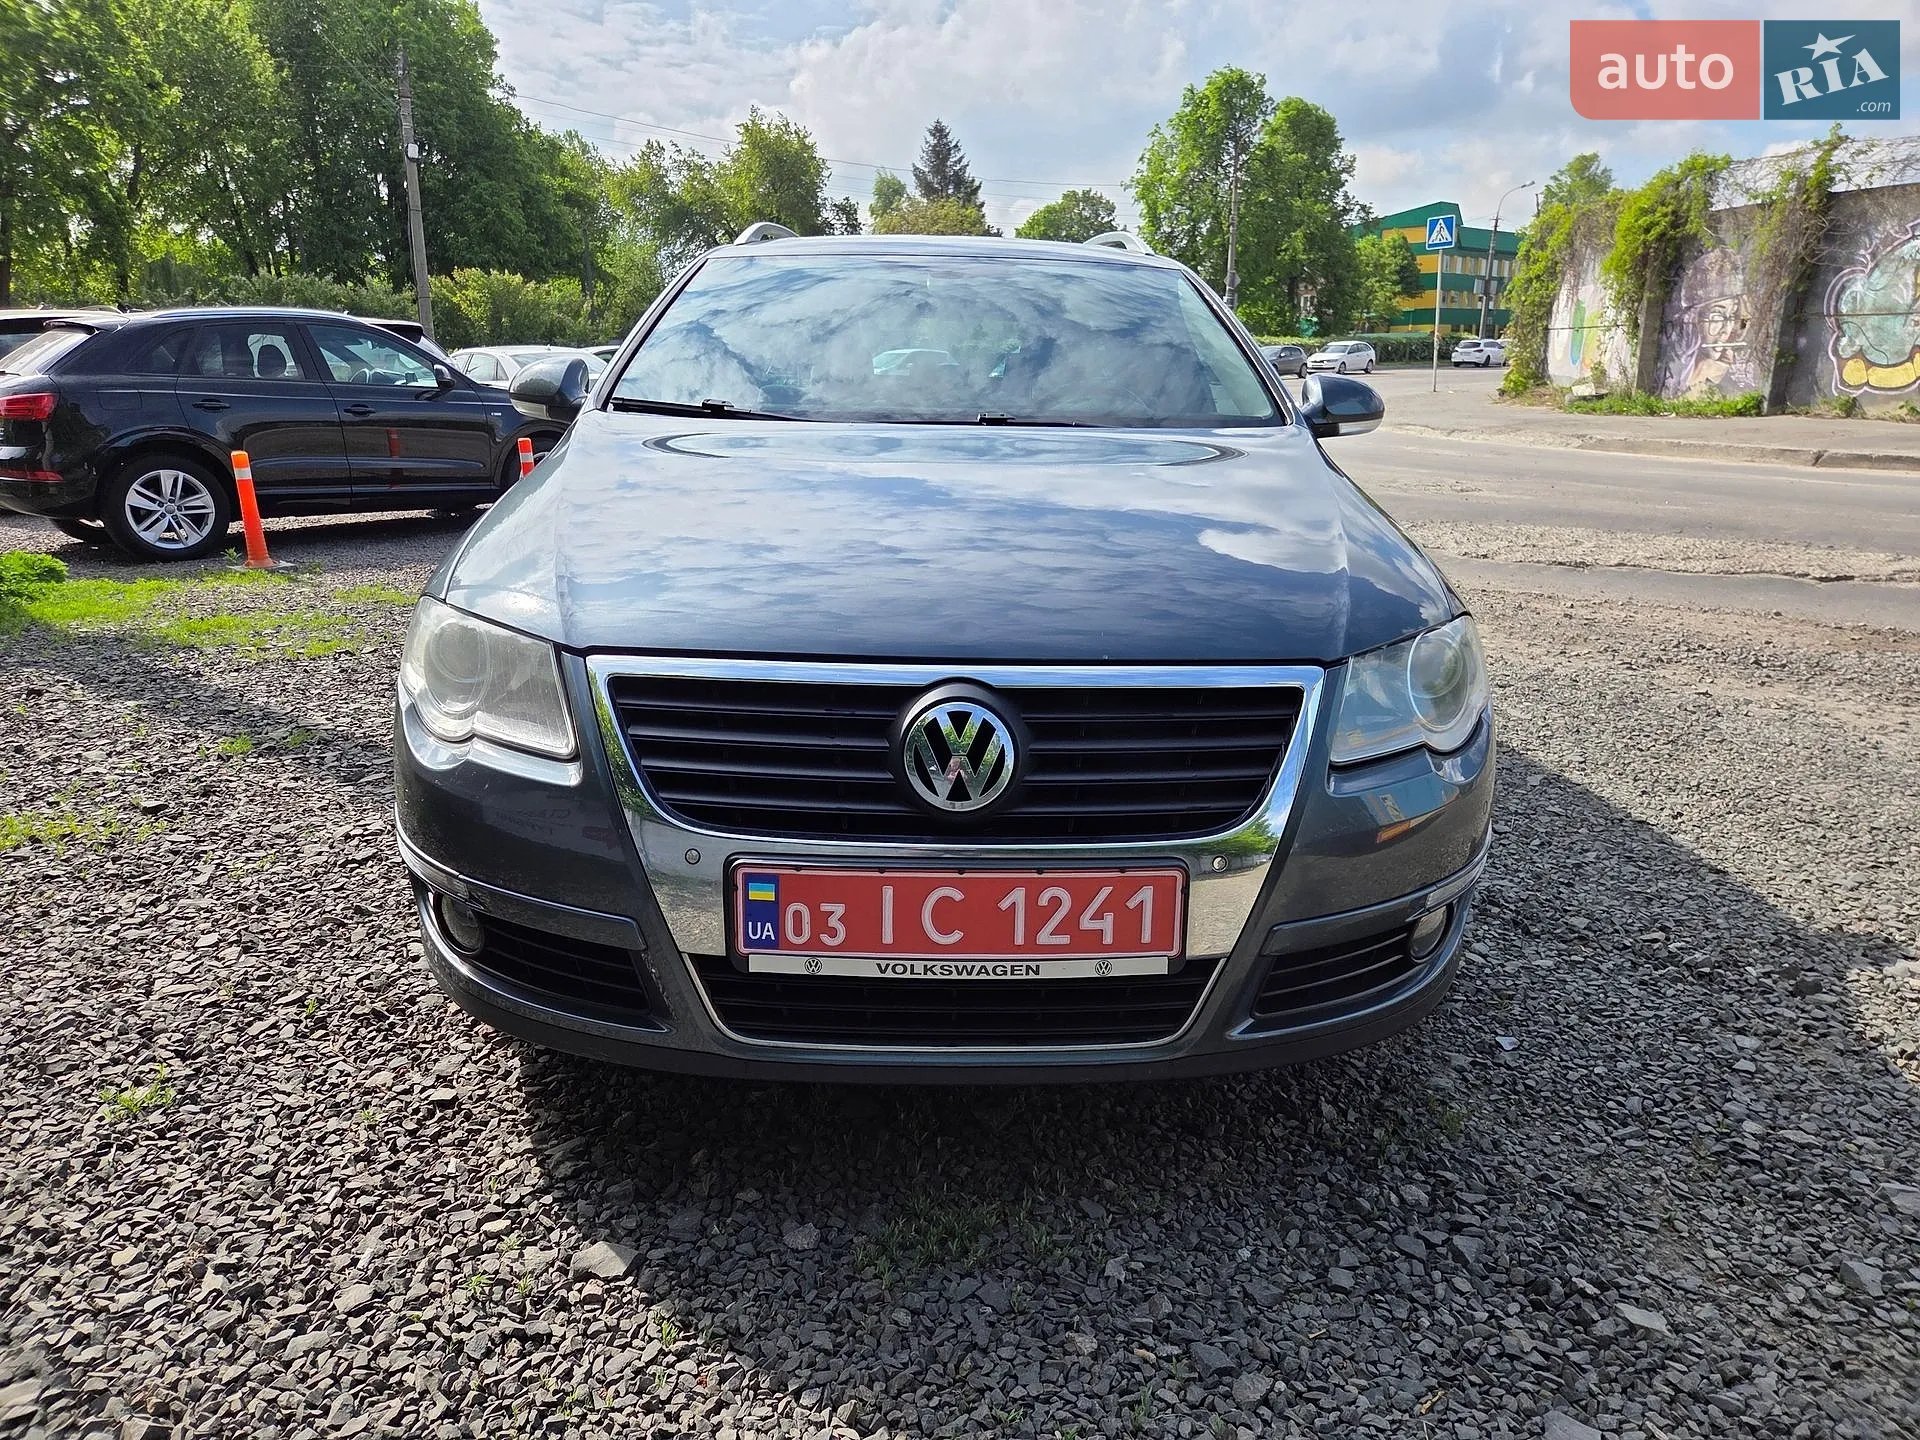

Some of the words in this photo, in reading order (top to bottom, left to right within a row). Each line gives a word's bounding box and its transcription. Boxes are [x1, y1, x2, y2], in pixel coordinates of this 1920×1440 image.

[784, 902, 846, 946] 03
[882, 885, 965, 945] IC
[998, 886, 1153, 945] 1241
[748, 921, 775, 940] UA
[876, 962, 1040, 977] VOLKSWAGEN
